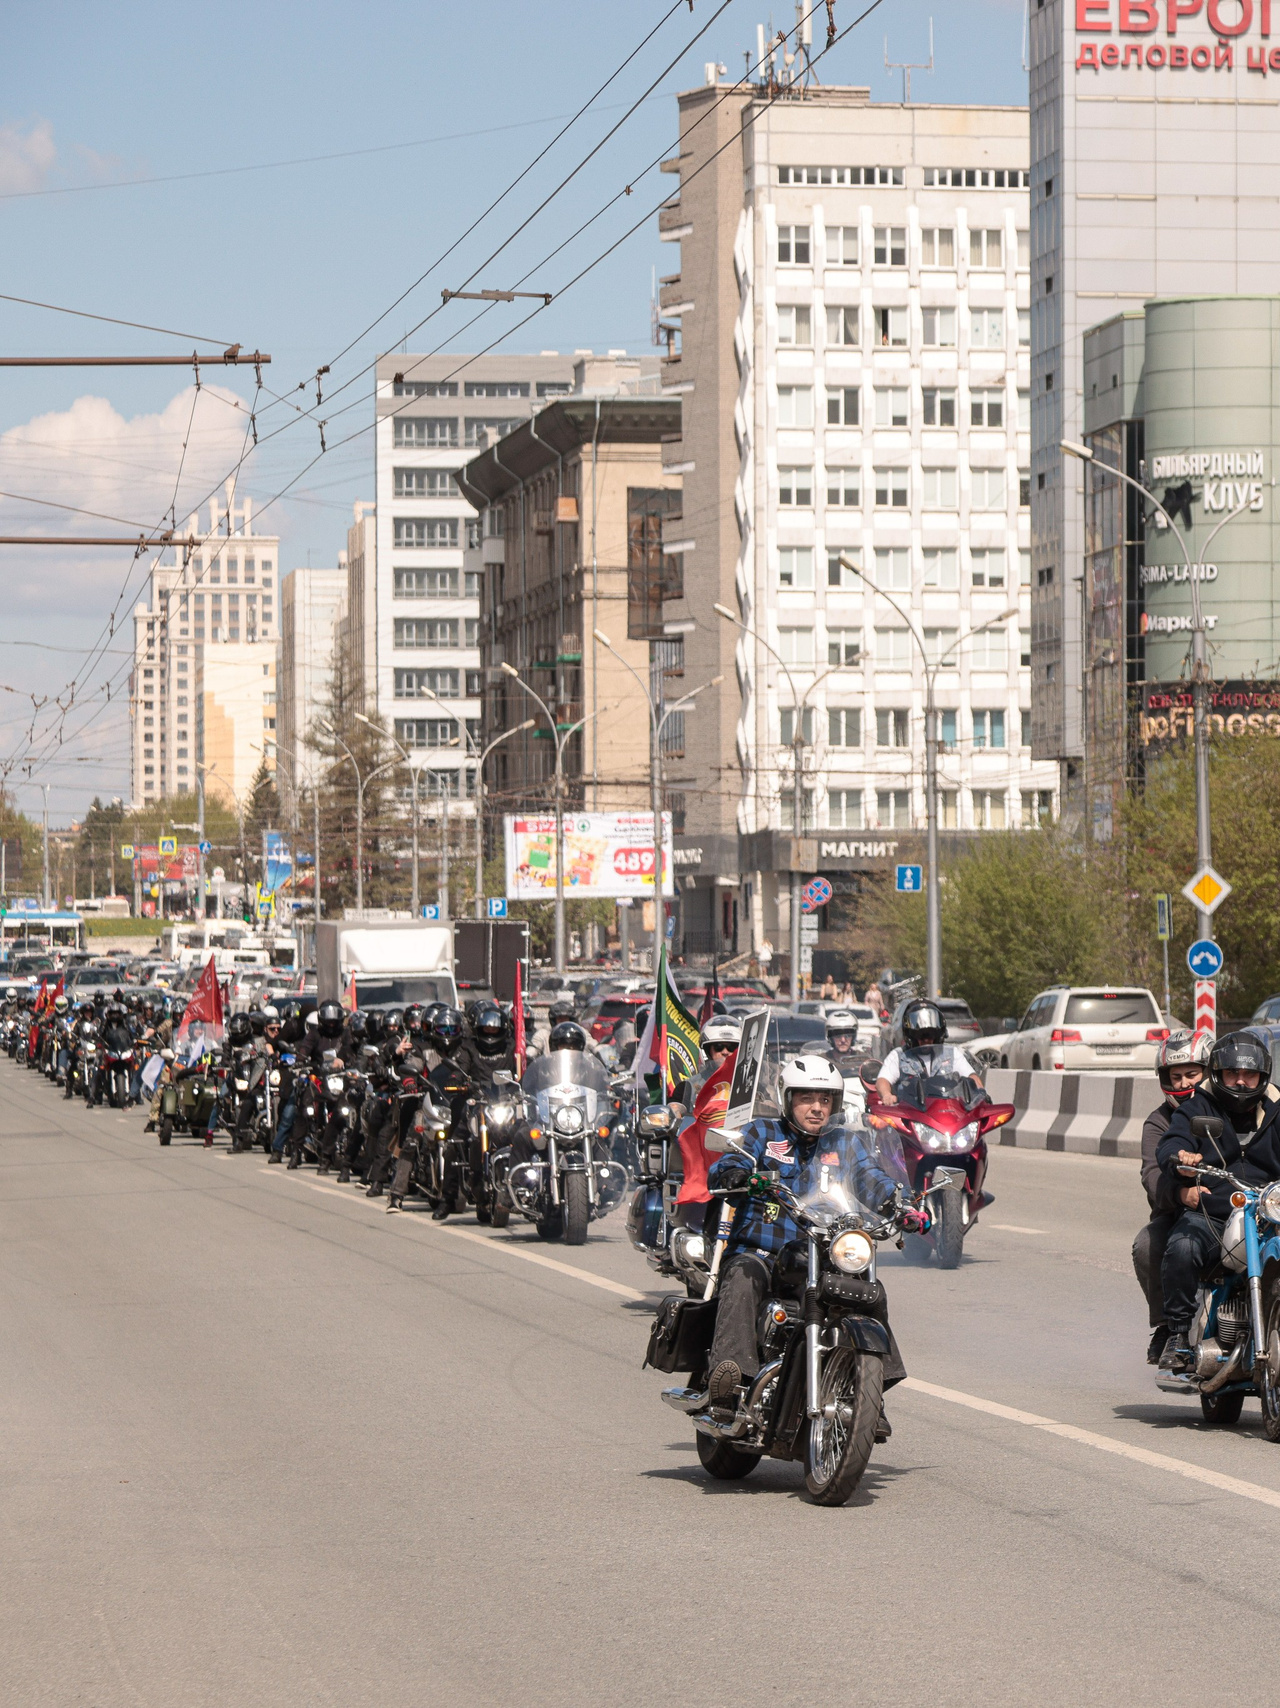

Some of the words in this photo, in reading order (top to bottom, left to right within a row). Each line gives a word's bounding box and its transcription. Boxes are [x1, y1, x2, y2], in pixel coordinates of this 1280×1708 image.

[1076, 38, 1234, 70] деловой
[1153, 449, 1264, 480] БИЛЬЯРДНЫЙ
[1204, 482, 1264, 511] КЛУБ
[1147, 615, 1218, 633] Маркт
[821, 841, 899, 858] МАГНИТ
